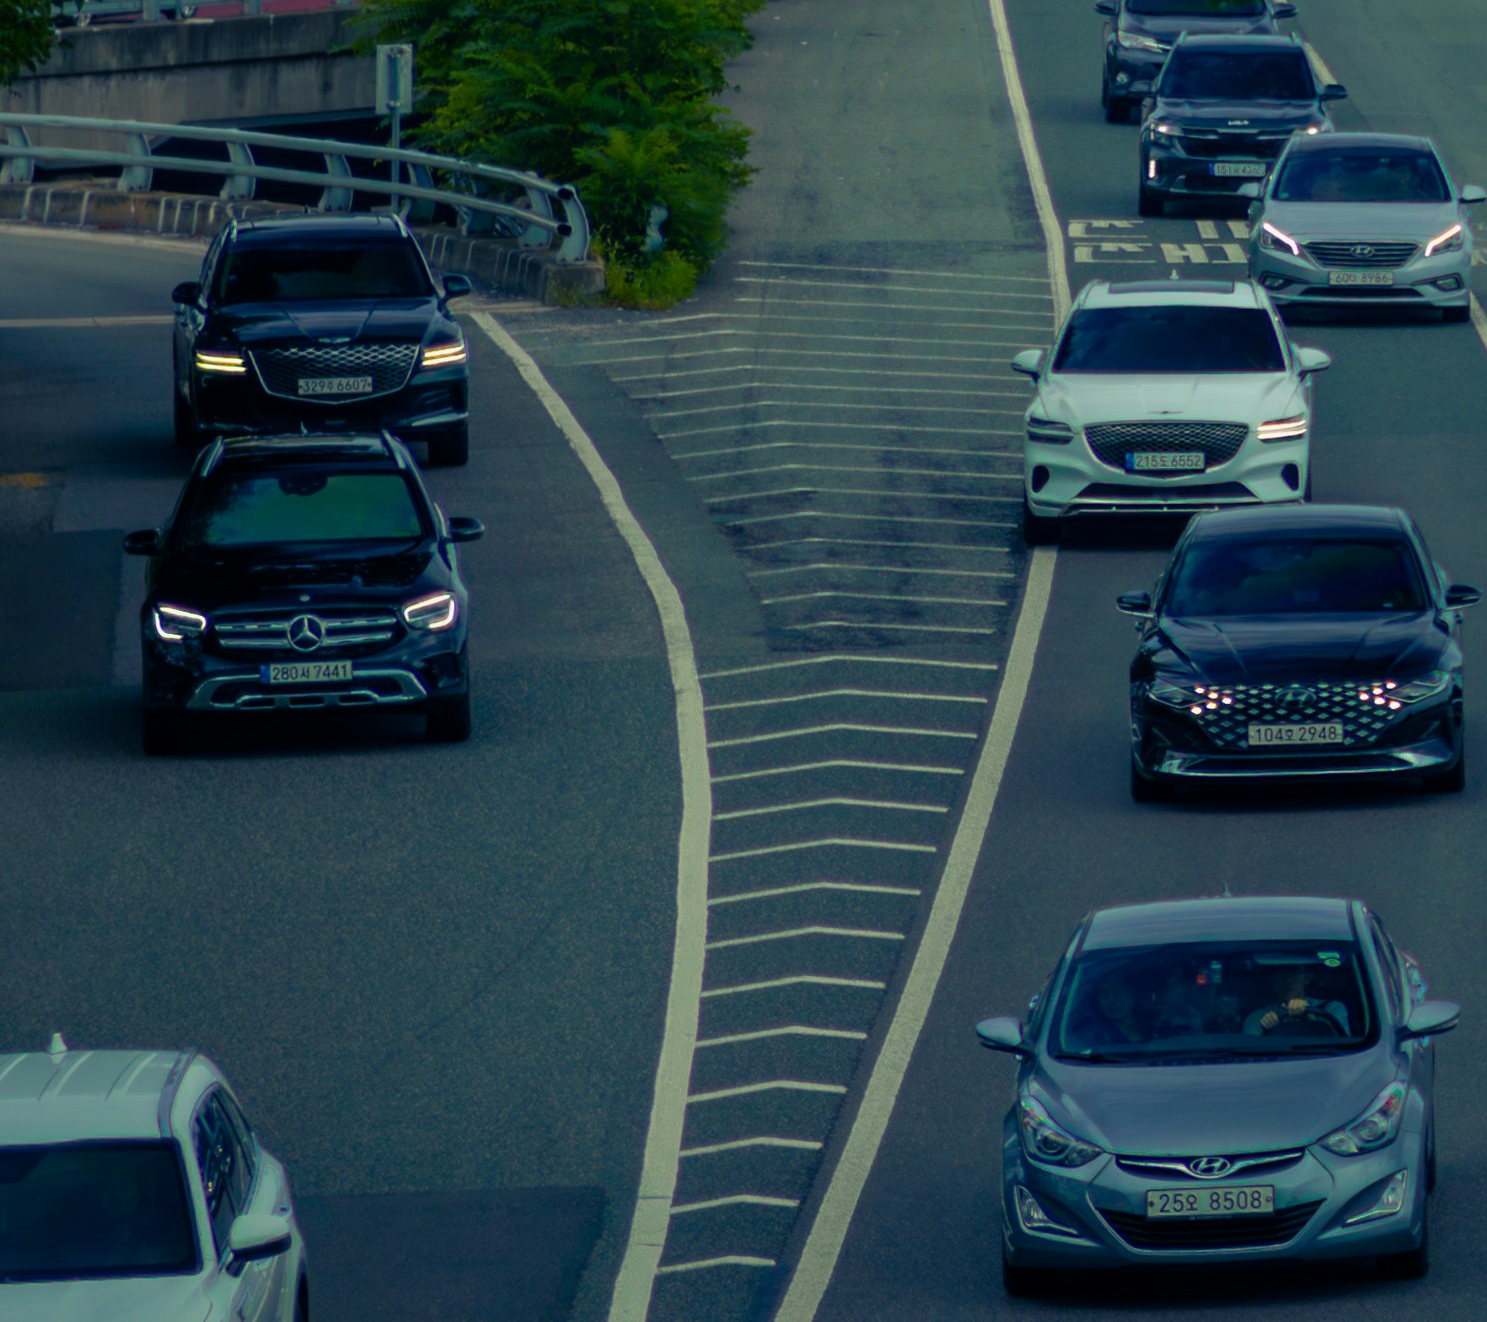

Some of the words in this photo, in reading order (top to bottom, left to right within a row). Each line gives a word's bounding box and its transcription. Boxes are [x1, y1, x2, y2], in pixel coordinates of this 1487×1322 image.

[1361, 272, 1387, 283] 8986
[337, 378, 369, 392] 6607
[1170, 453, 1202, 467] 6552
[313, 663, 348, 679] 7441
[1298, 724, 1338, 741] 2948
[1158, 1193, 1199, 1213] 25오
[1209, 1190, 1262, 1211] 8508
